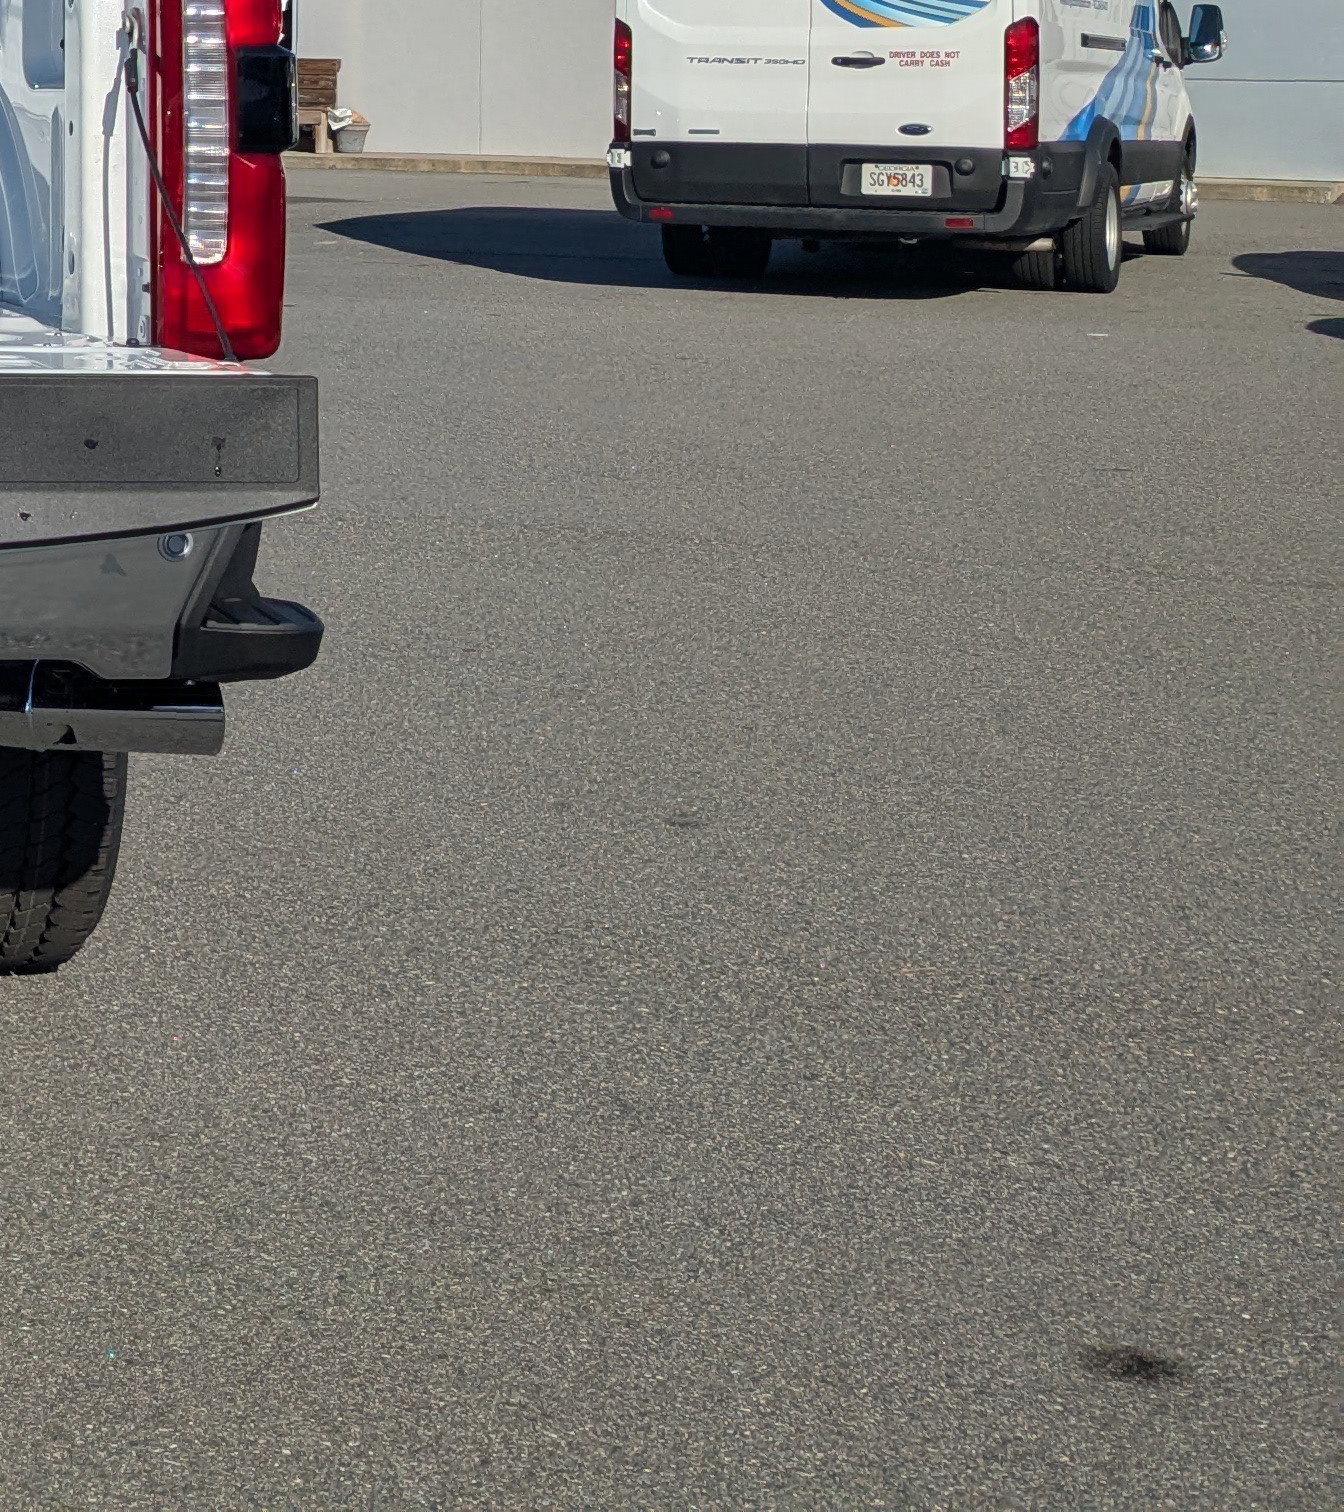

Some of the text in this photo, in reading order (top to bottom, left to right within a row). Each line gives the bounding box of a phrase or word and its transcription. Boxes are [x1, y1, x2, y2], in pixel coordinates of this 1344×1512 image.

[888, 50, 961, 59] DRIVER DOES NOT
[686, 56, 762, 65] TRANSIT
[898, 59, 951, 68] CARRY CASH
[869, 171, 924, 188] SGY5843
